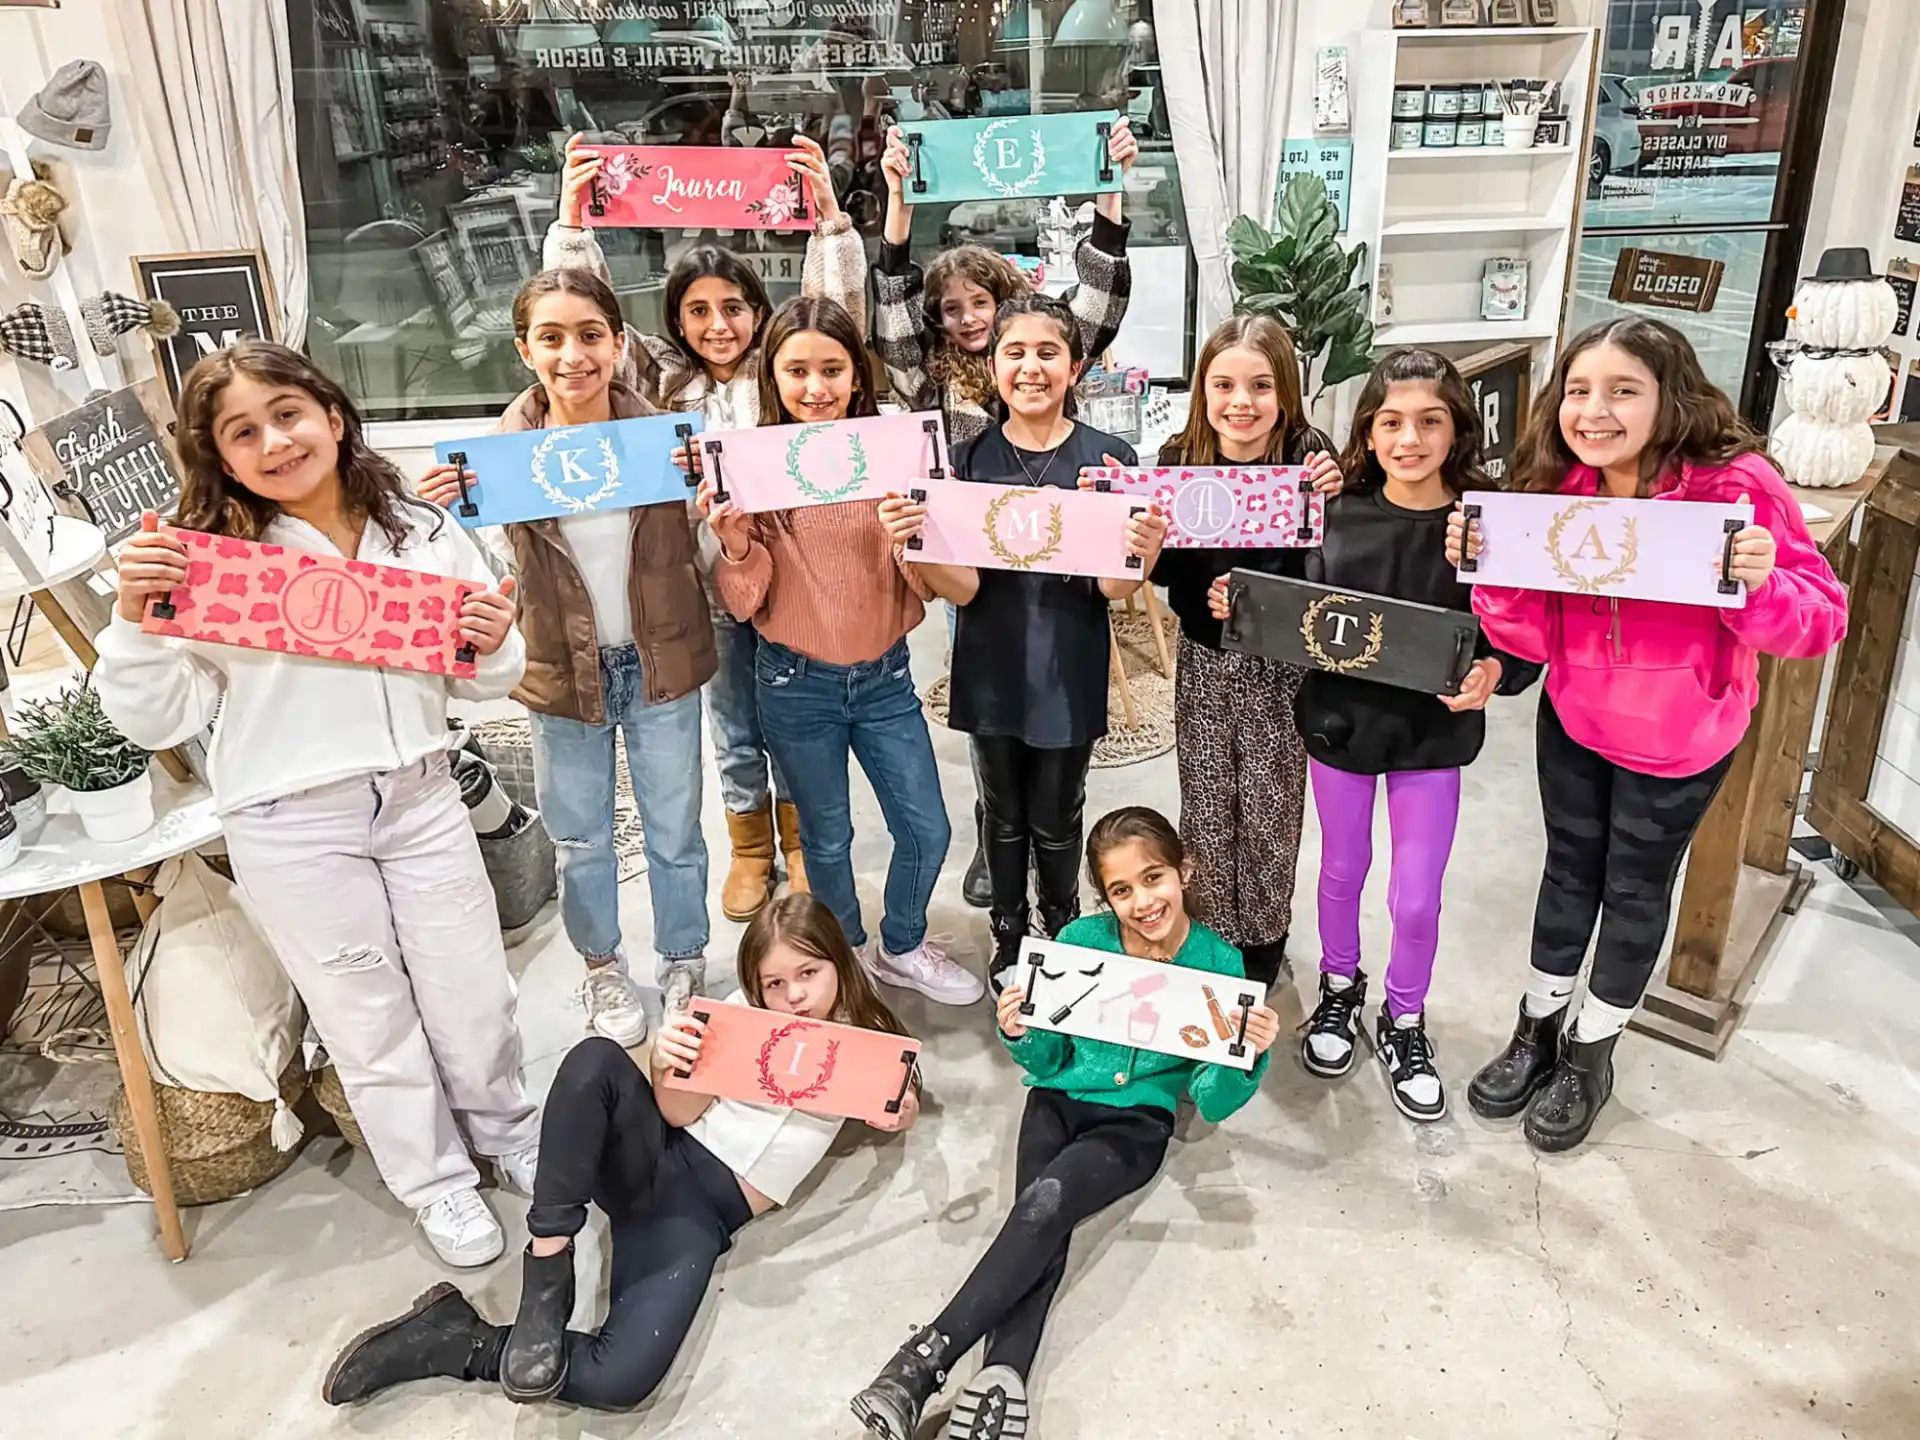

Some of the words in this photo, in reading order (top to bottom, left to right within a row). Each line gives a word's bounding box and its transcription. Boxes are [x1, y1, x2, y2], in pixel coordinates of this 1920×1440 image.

[993, 137, 1023, 170] E
[1320, 150, 1340, 162] $24
[652, 163, 748, 213] Lauren
[1325, 170, 1344, 181] $10
[1632, 273, 1701, 295] CLOSED
[181, 305, 240, 322] THE
[55, 406, 128, 492] Fresh
[555, 447, 600, 484] K
[89, 440, 176, 530] COFFEE
[1003, 507, 1043, 541] M
[1185, 484, 1223, 530] A
[1568, 523, 1613, 561] A
[300, 577, 352, 635] A
[1325, 611, 1359, 646] T
[786, 1041, 808, 1076] I
